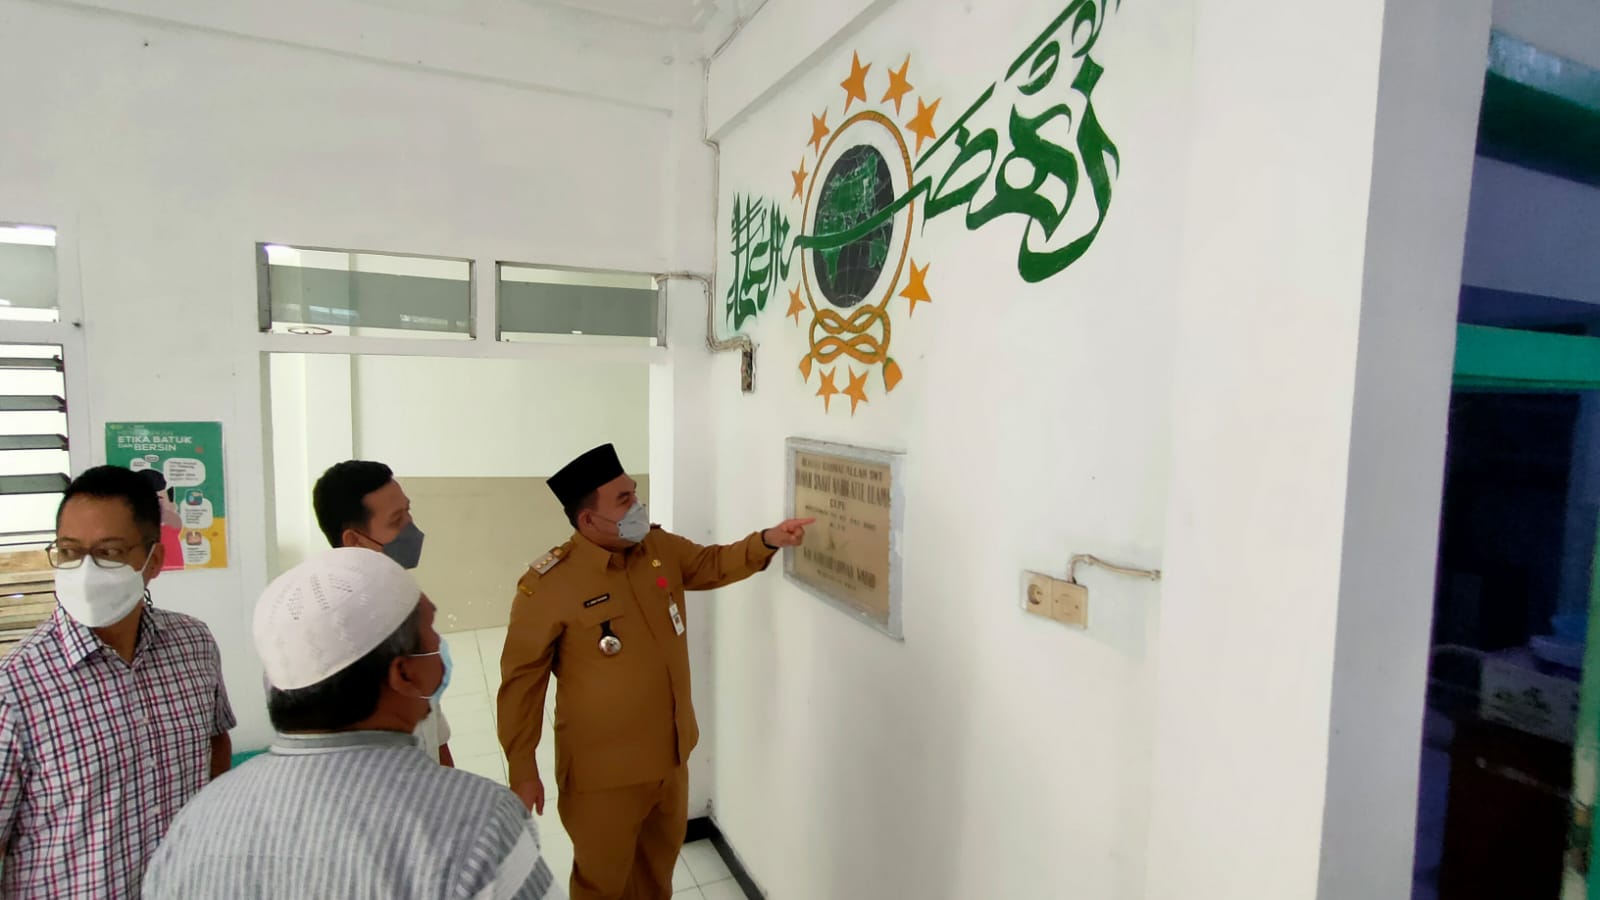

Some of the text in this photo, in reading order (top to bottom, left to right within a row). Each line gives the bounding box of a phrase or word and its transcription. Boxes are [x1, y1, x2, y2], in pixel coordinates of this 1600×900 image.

[117, 435, 193, 444] ETIKA BATUK
[134, 443, 177, 452] BERSIN
